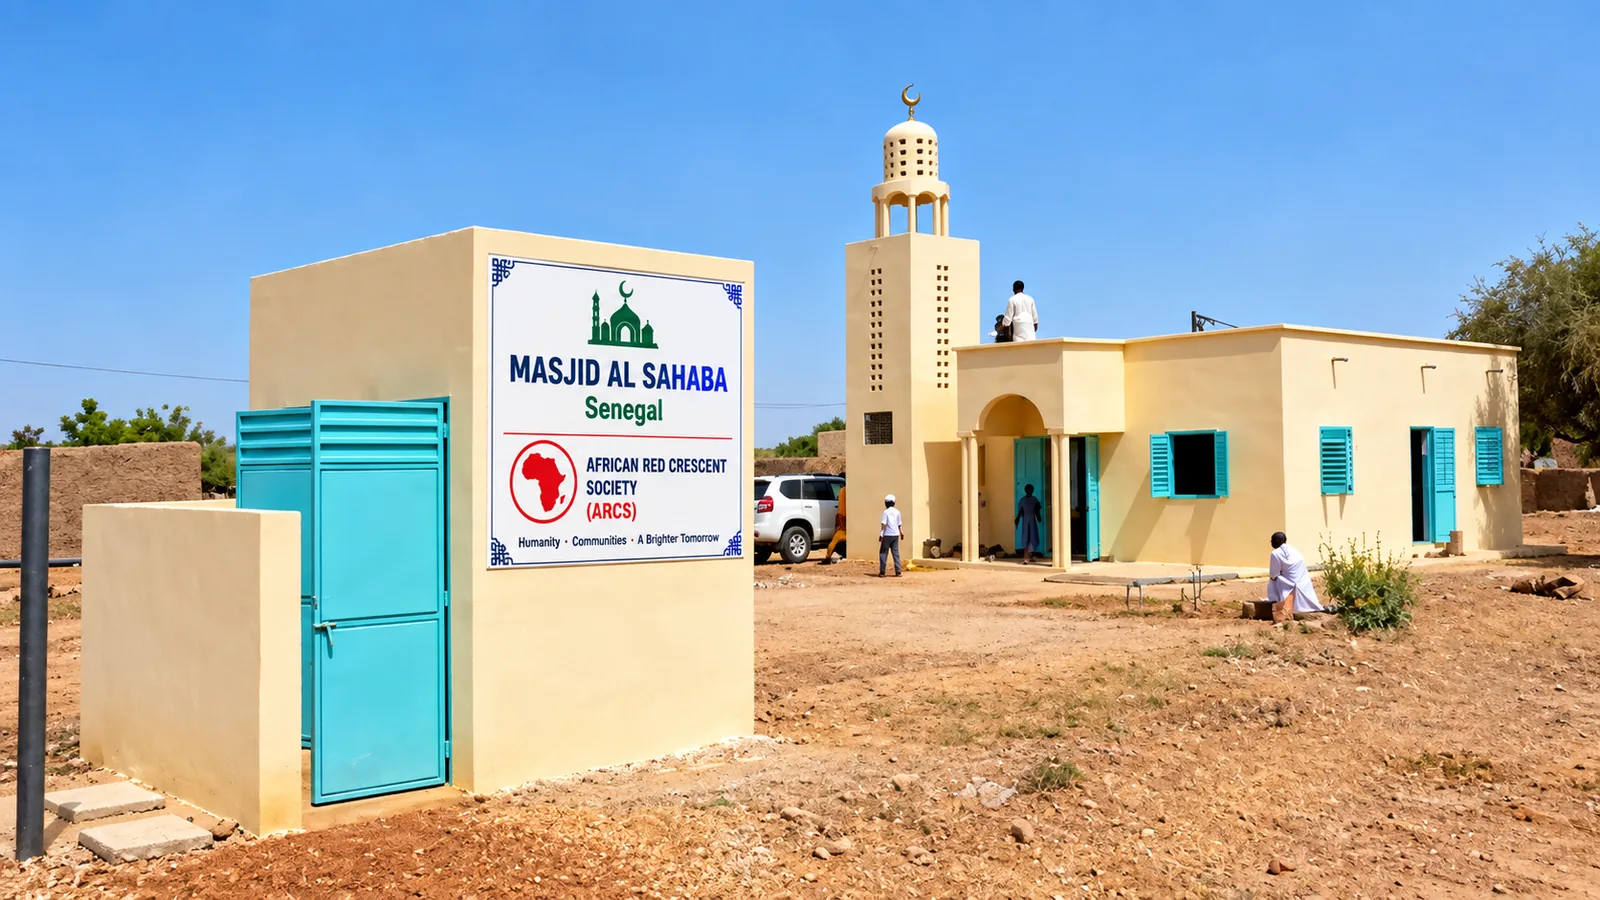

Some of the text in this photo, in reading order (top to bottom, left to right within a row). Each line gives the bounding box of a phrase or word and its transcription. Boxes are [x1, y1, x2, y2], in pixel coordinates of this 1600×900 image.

[510, 355, 728, 392] MASJID AL SAHABA
[585, 396, 662, 426] Senegal
[586, 457, 727, 473] AFRICAN RED CRESCENT
[587, 480, 637, 495] SOCIETY
[587, 502, 636, 522] (ARCS)
[519, 533, 719, 549] Humanity Communities A Brighter Tomorrow
